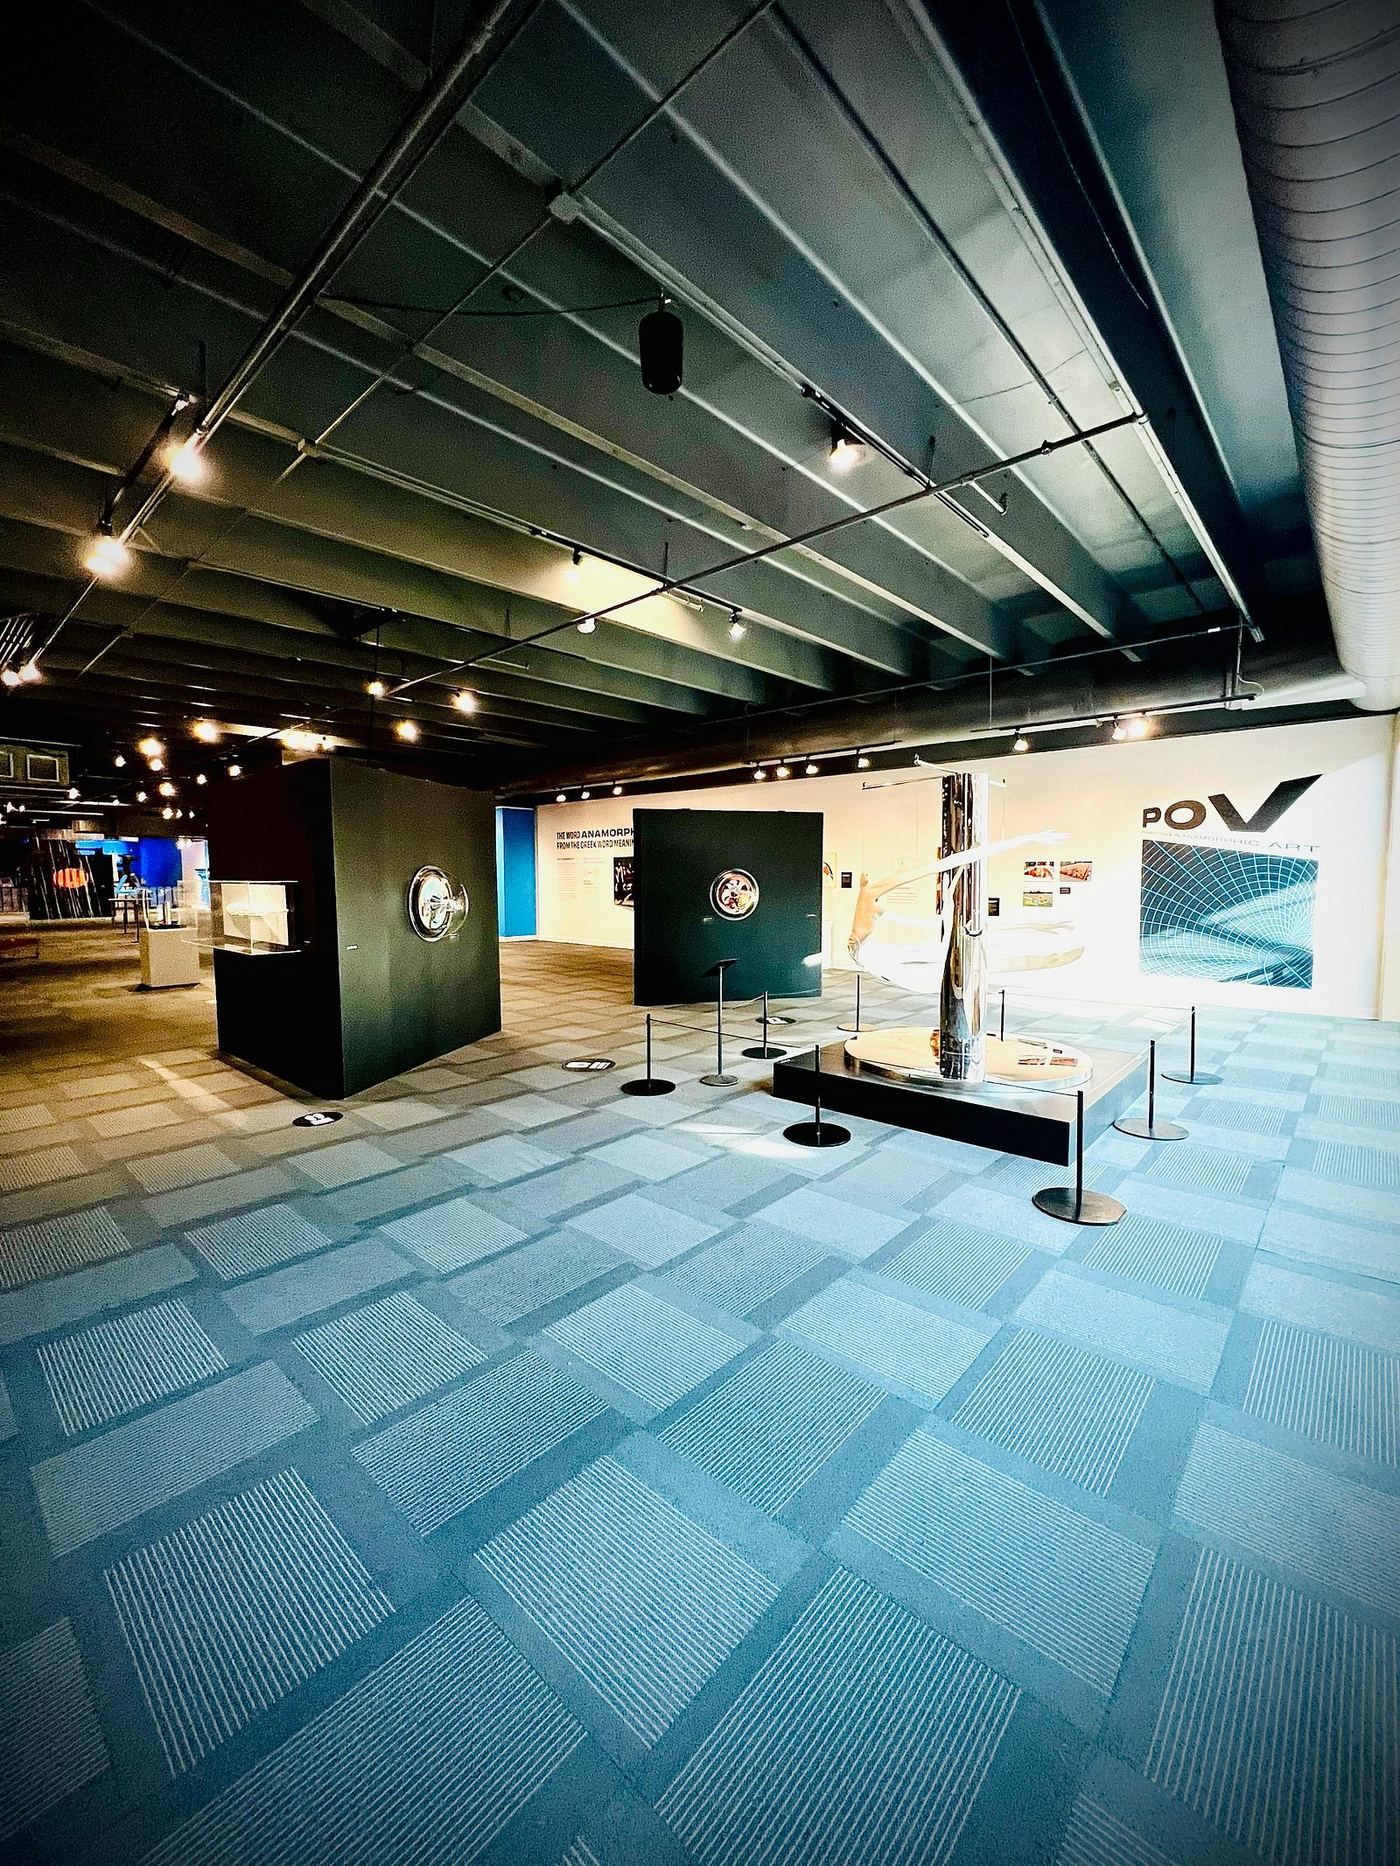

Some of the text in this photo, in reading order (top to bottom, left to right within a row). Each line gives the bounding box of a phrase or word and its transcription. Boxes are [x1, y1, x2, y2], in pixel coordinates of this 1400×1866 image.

[1142, 773, 1323, 833] POV
[556, 832, 566, 840] THE
[566, 831, 580, 840] WORD
[556, 841, 570, 850] FROM
[571, 841, 580, 849] THE
[580, 840, 597, 849] GREEK
[597, 839, 613, 848] WORD
[1268, 842, 1320, 852] ART
